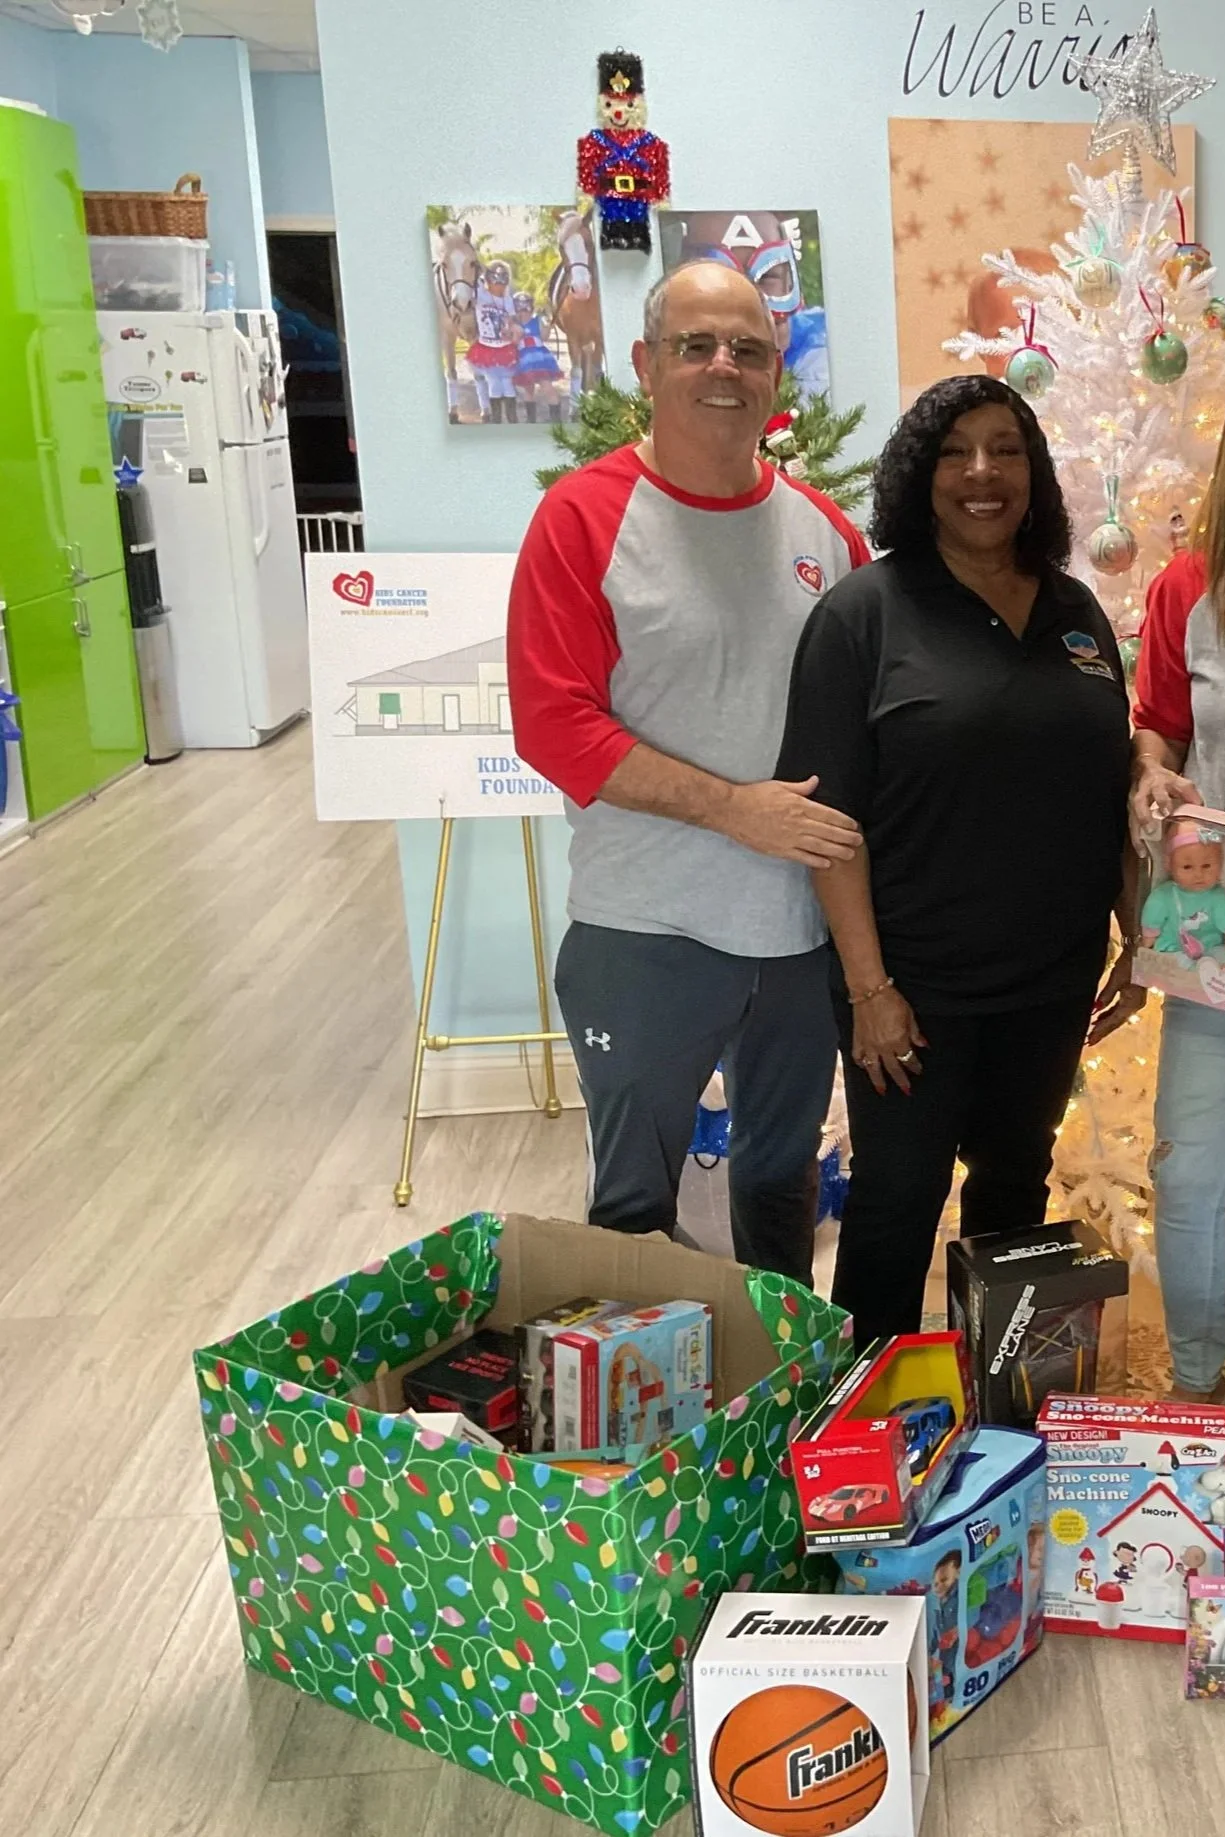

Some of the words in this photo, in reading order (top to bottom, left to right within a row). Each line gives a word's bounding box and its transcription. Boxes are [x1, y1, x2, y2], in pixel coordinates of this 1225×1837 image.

[1018, 1, 1056, 26] BE
[1075, 3, 1094, 27] A
[478, 757, 521, 774] KIDS
[481, 779, 561, 795] FOUNDA
[989, 1284, 1036, 1375] EXPRESS
[1007, 1305, 1036, 1357] LANE
[1050, 1401, 1149, 1416] Snoopy
[1047, 1411, 1138, 1423] Sno-cone
[1141, 1414, 1225, 1425] Machine
[1047, 1431, 1072, 1441] NEW
[1074, 1430, 1108, 1441] DESIGN!
[1047, 1445, 1128, 1464] Snoopy
[1046, 1470, 1131, 1485] Sno-cone
[1047, 1486, 1130, 1501] Machine
[1141, 1507, 1178, 1518] SNOOPY
[700, 1666, 761, 1677] OFFICIAL
[768, 1667, 796, 1677] SIZE
[803, 1668, 888, 1678] BASKETBALL
[963, 1670, 989, 1697] 80
[787, 1724, 884, 1799] Frankl
